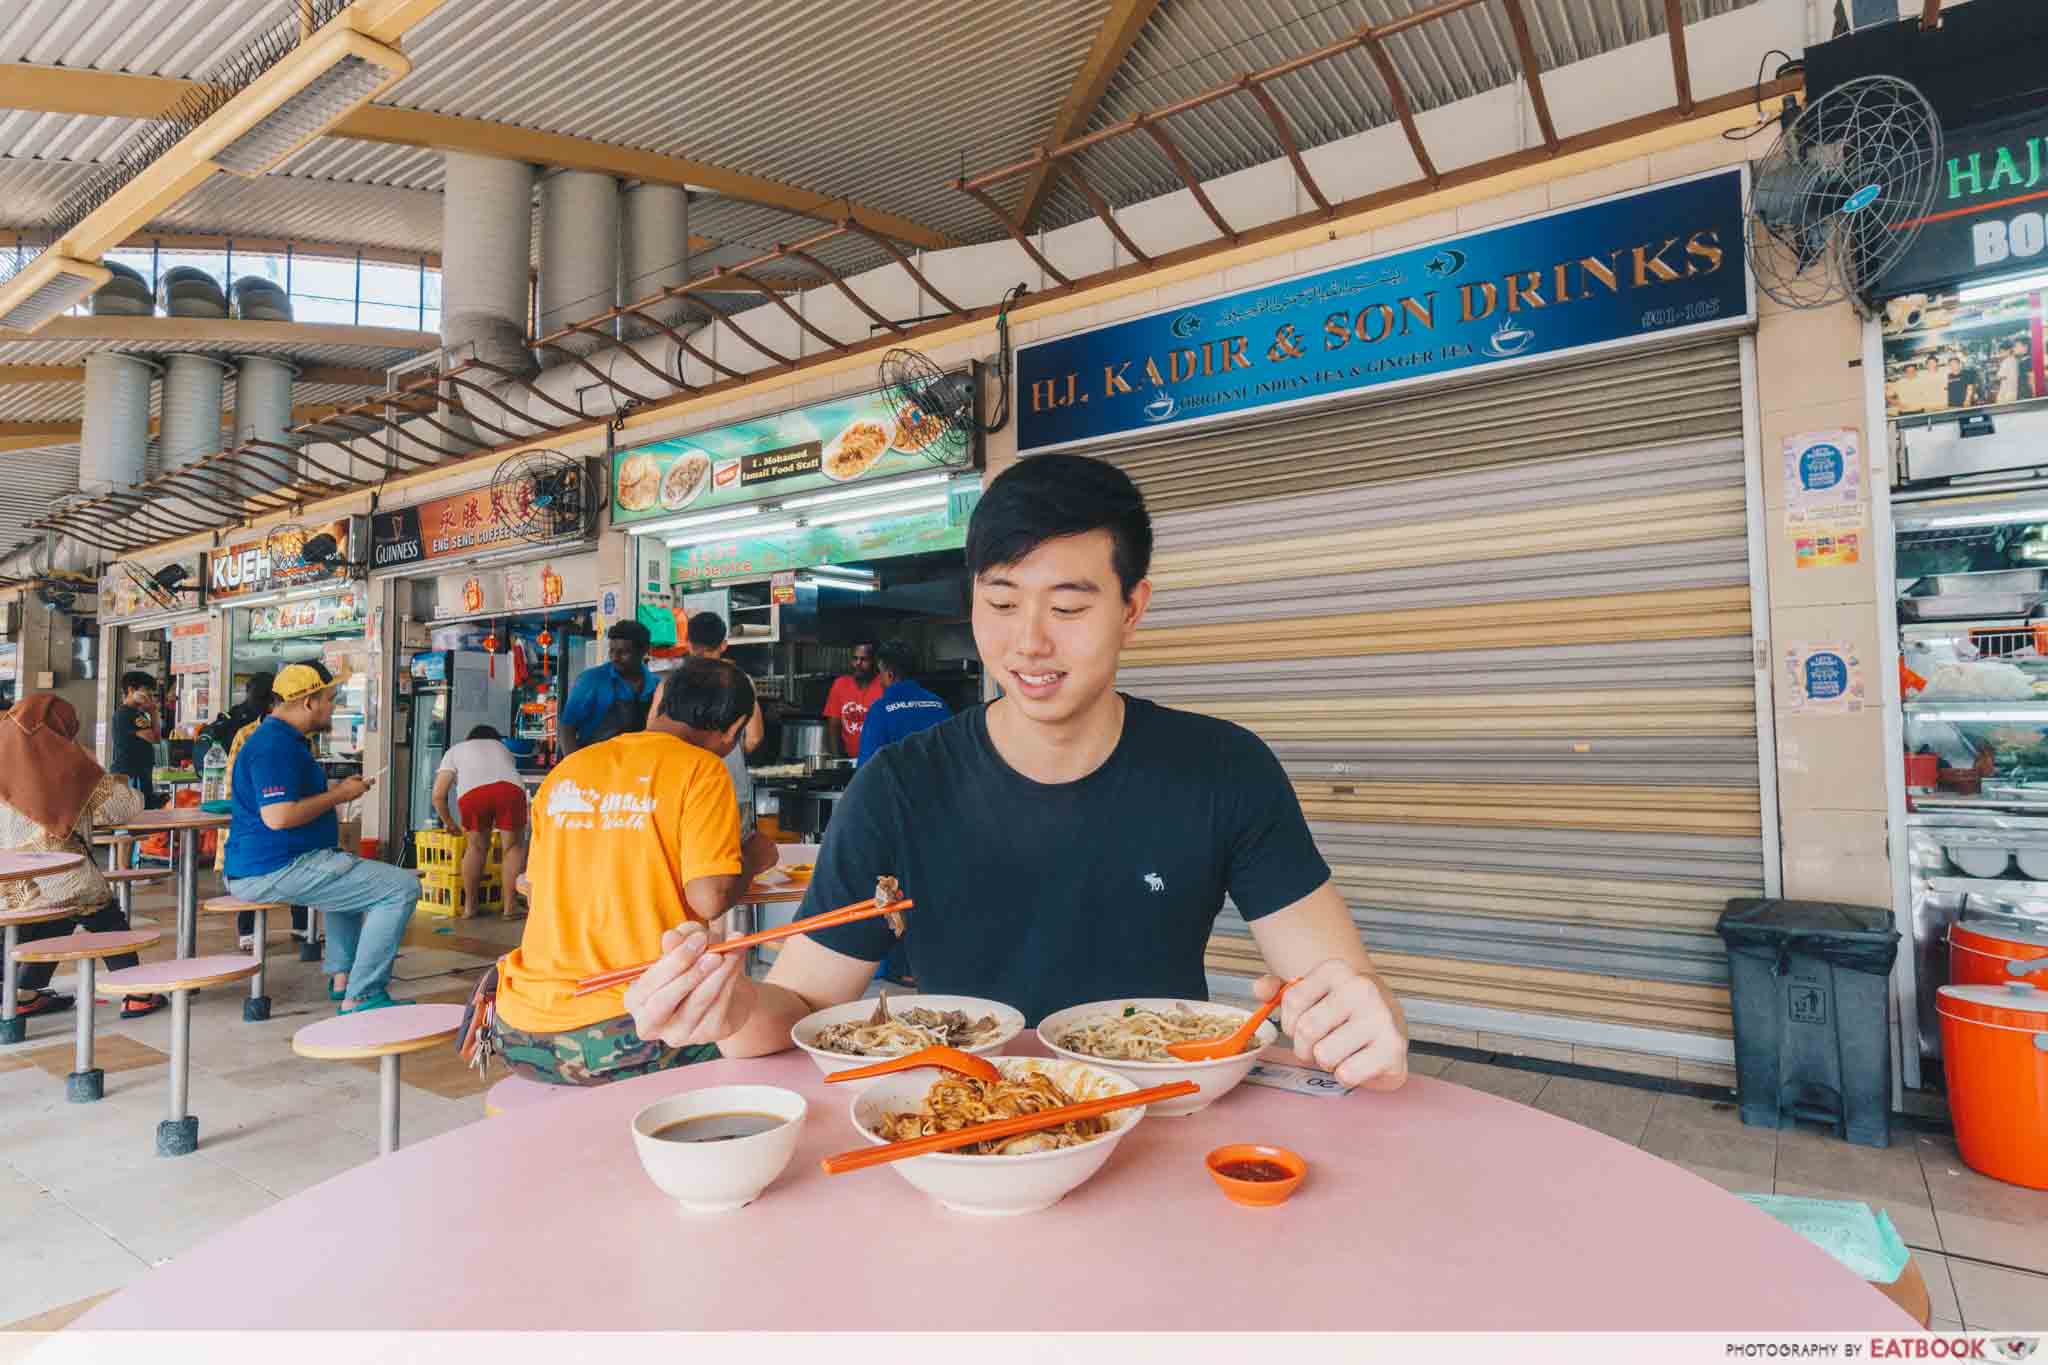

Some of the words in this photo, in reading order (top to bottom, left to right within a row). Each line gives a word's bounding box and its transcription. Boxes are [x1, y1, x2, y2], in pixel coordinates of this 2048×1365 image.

[1946, 137, 2048, 199] HAJ
[1972, 211, 2048, 267] BO
[1031, 371, 1089, 415] HJ.
[1103, 335, 1254, 397] KADIR
[1266, 322, 1306, 363] &
[1322, 290, 1440, 352] SON
[1455, 228, 1723, 324] DRINKS
[1180, 385, 1247, 409] ORIGINAL
[1256, 375, 1308, 395] INDIAN
[1313, 366, 1345, 384] TEA
[1349, 366, 1361, 377] &
[1367, 351, 1433, 374] GINGER
[1440, 343, 1473, 361] TEA
[764, 448, 809, 466] Mohamed
[771, 462, 795, 477] Food
[375, 540, 419, 565] GUINNESS
[432, 538, 449, 553] ENG
[451, 534, 474, 549] SENG
[479, 526, 511, 545] COFFEE
[211, 547, 272, 590] KUEH
